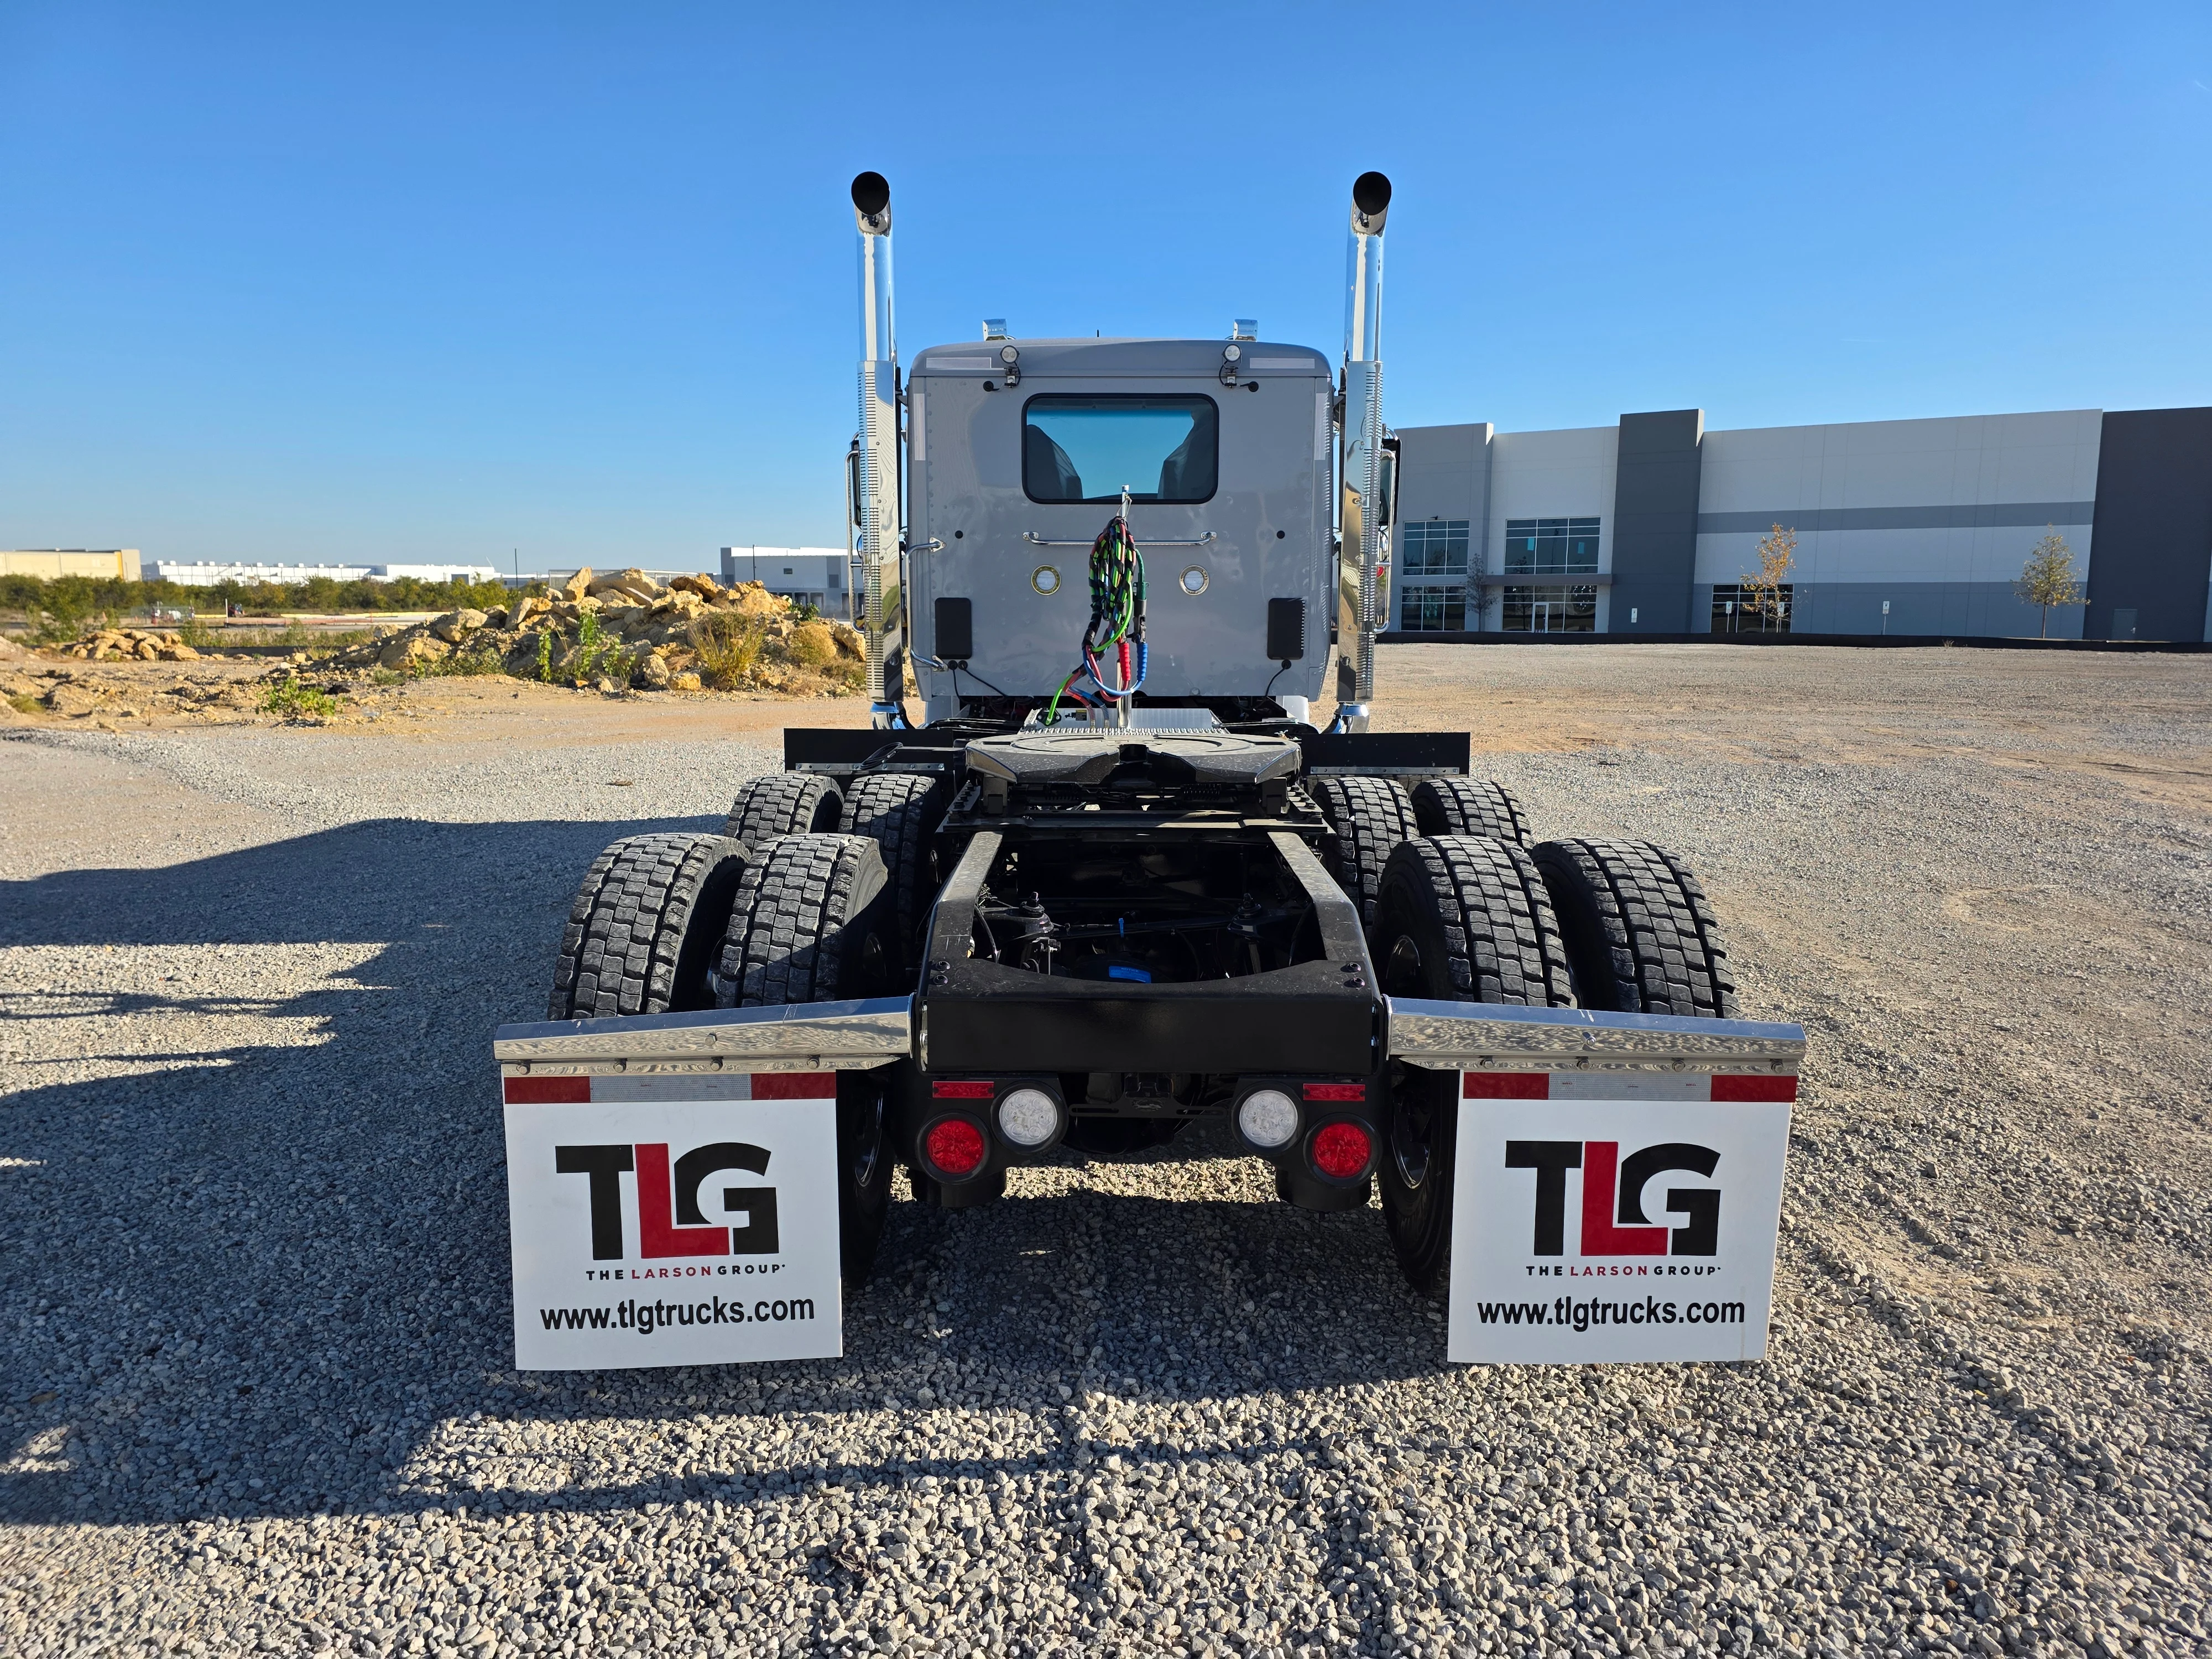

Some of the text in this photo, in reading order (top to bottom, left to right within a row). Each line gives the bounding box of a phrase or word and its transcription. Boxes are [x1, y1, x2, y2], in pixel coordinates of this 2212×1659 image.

[555, 1142, 780, 1261] TLG
[1505, 1140, 1721, 1256] TLG
[586, 1264, 780, 1281] THE LARSON GROUP
[1526, 1265, 1715, 1276] THE LARSON GROUP
[540, 1296, 815, 1335] www.tlgtrucks.com
[1477, 1295, 1745, 1332] www.tlgtrucks.com
